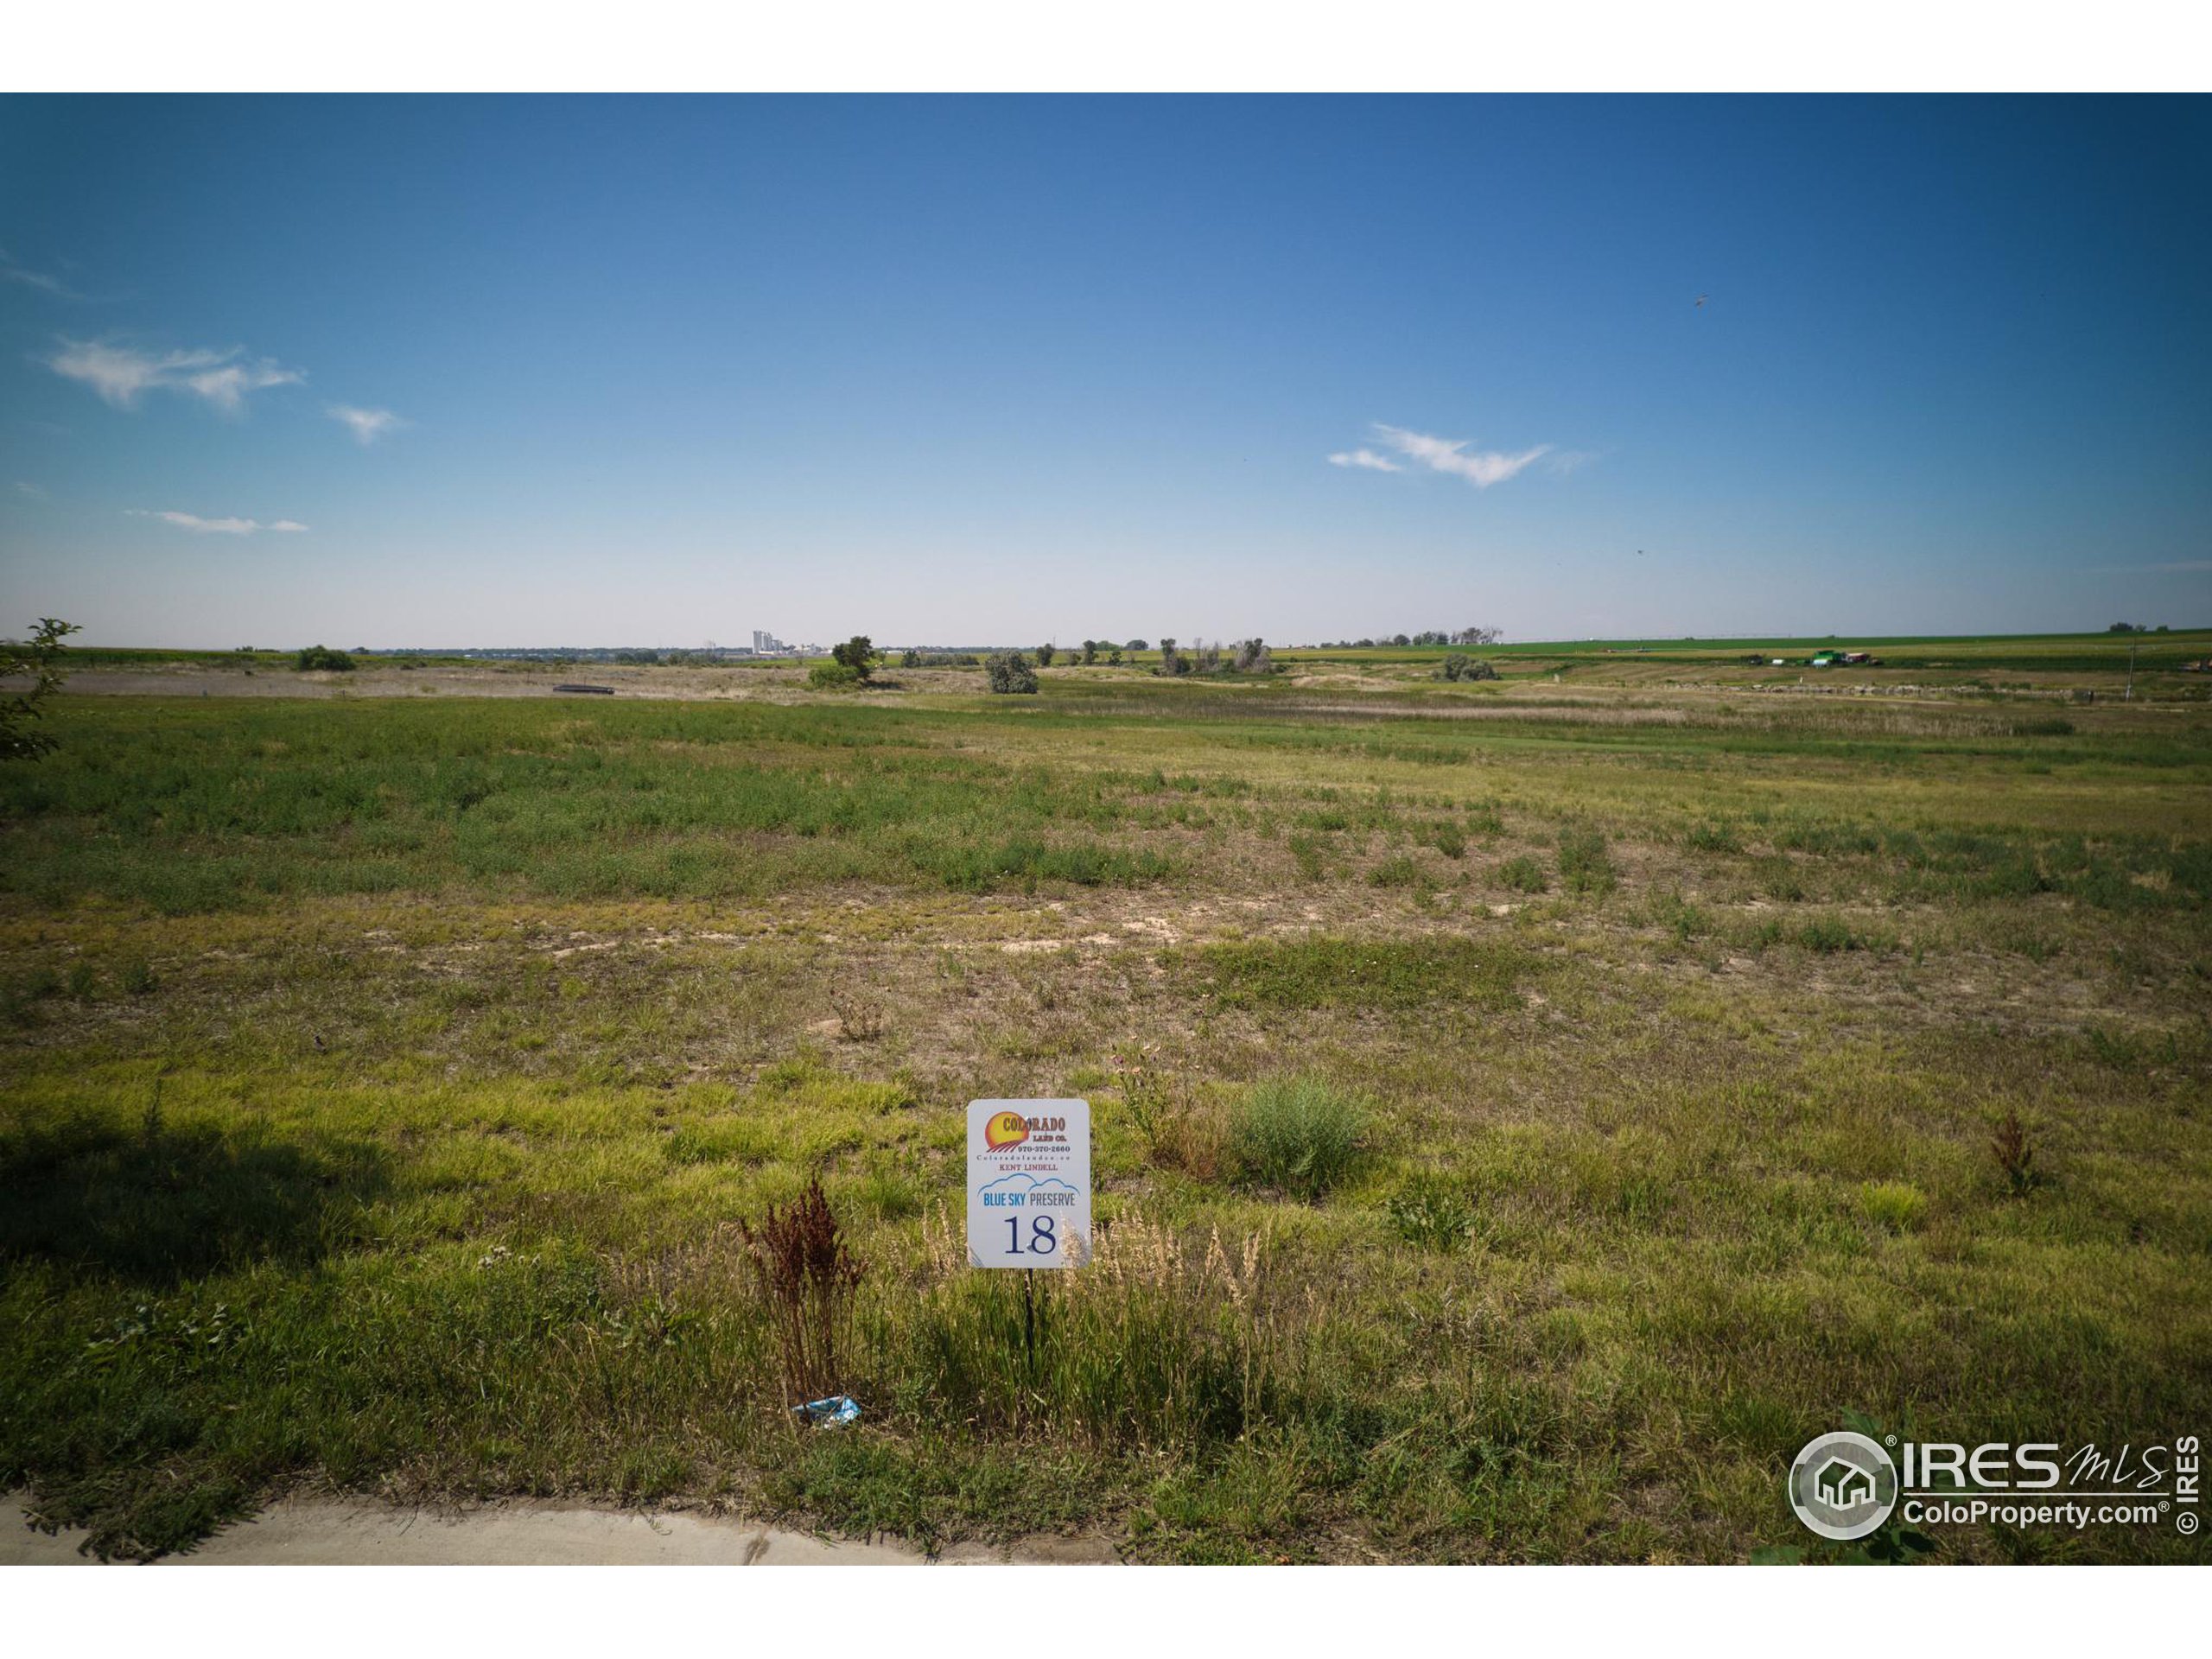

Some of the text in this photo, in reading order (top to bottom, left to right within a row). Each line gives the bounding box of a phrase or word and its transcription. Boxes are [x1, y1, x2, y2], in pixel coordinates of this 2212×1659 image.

[1003, 1117, 1065, 1131] COLORADO
[983, 1192, 1076, 1206] BLUE SKY PRESERVE
[1004, 1215, 1056, 1255] 18
